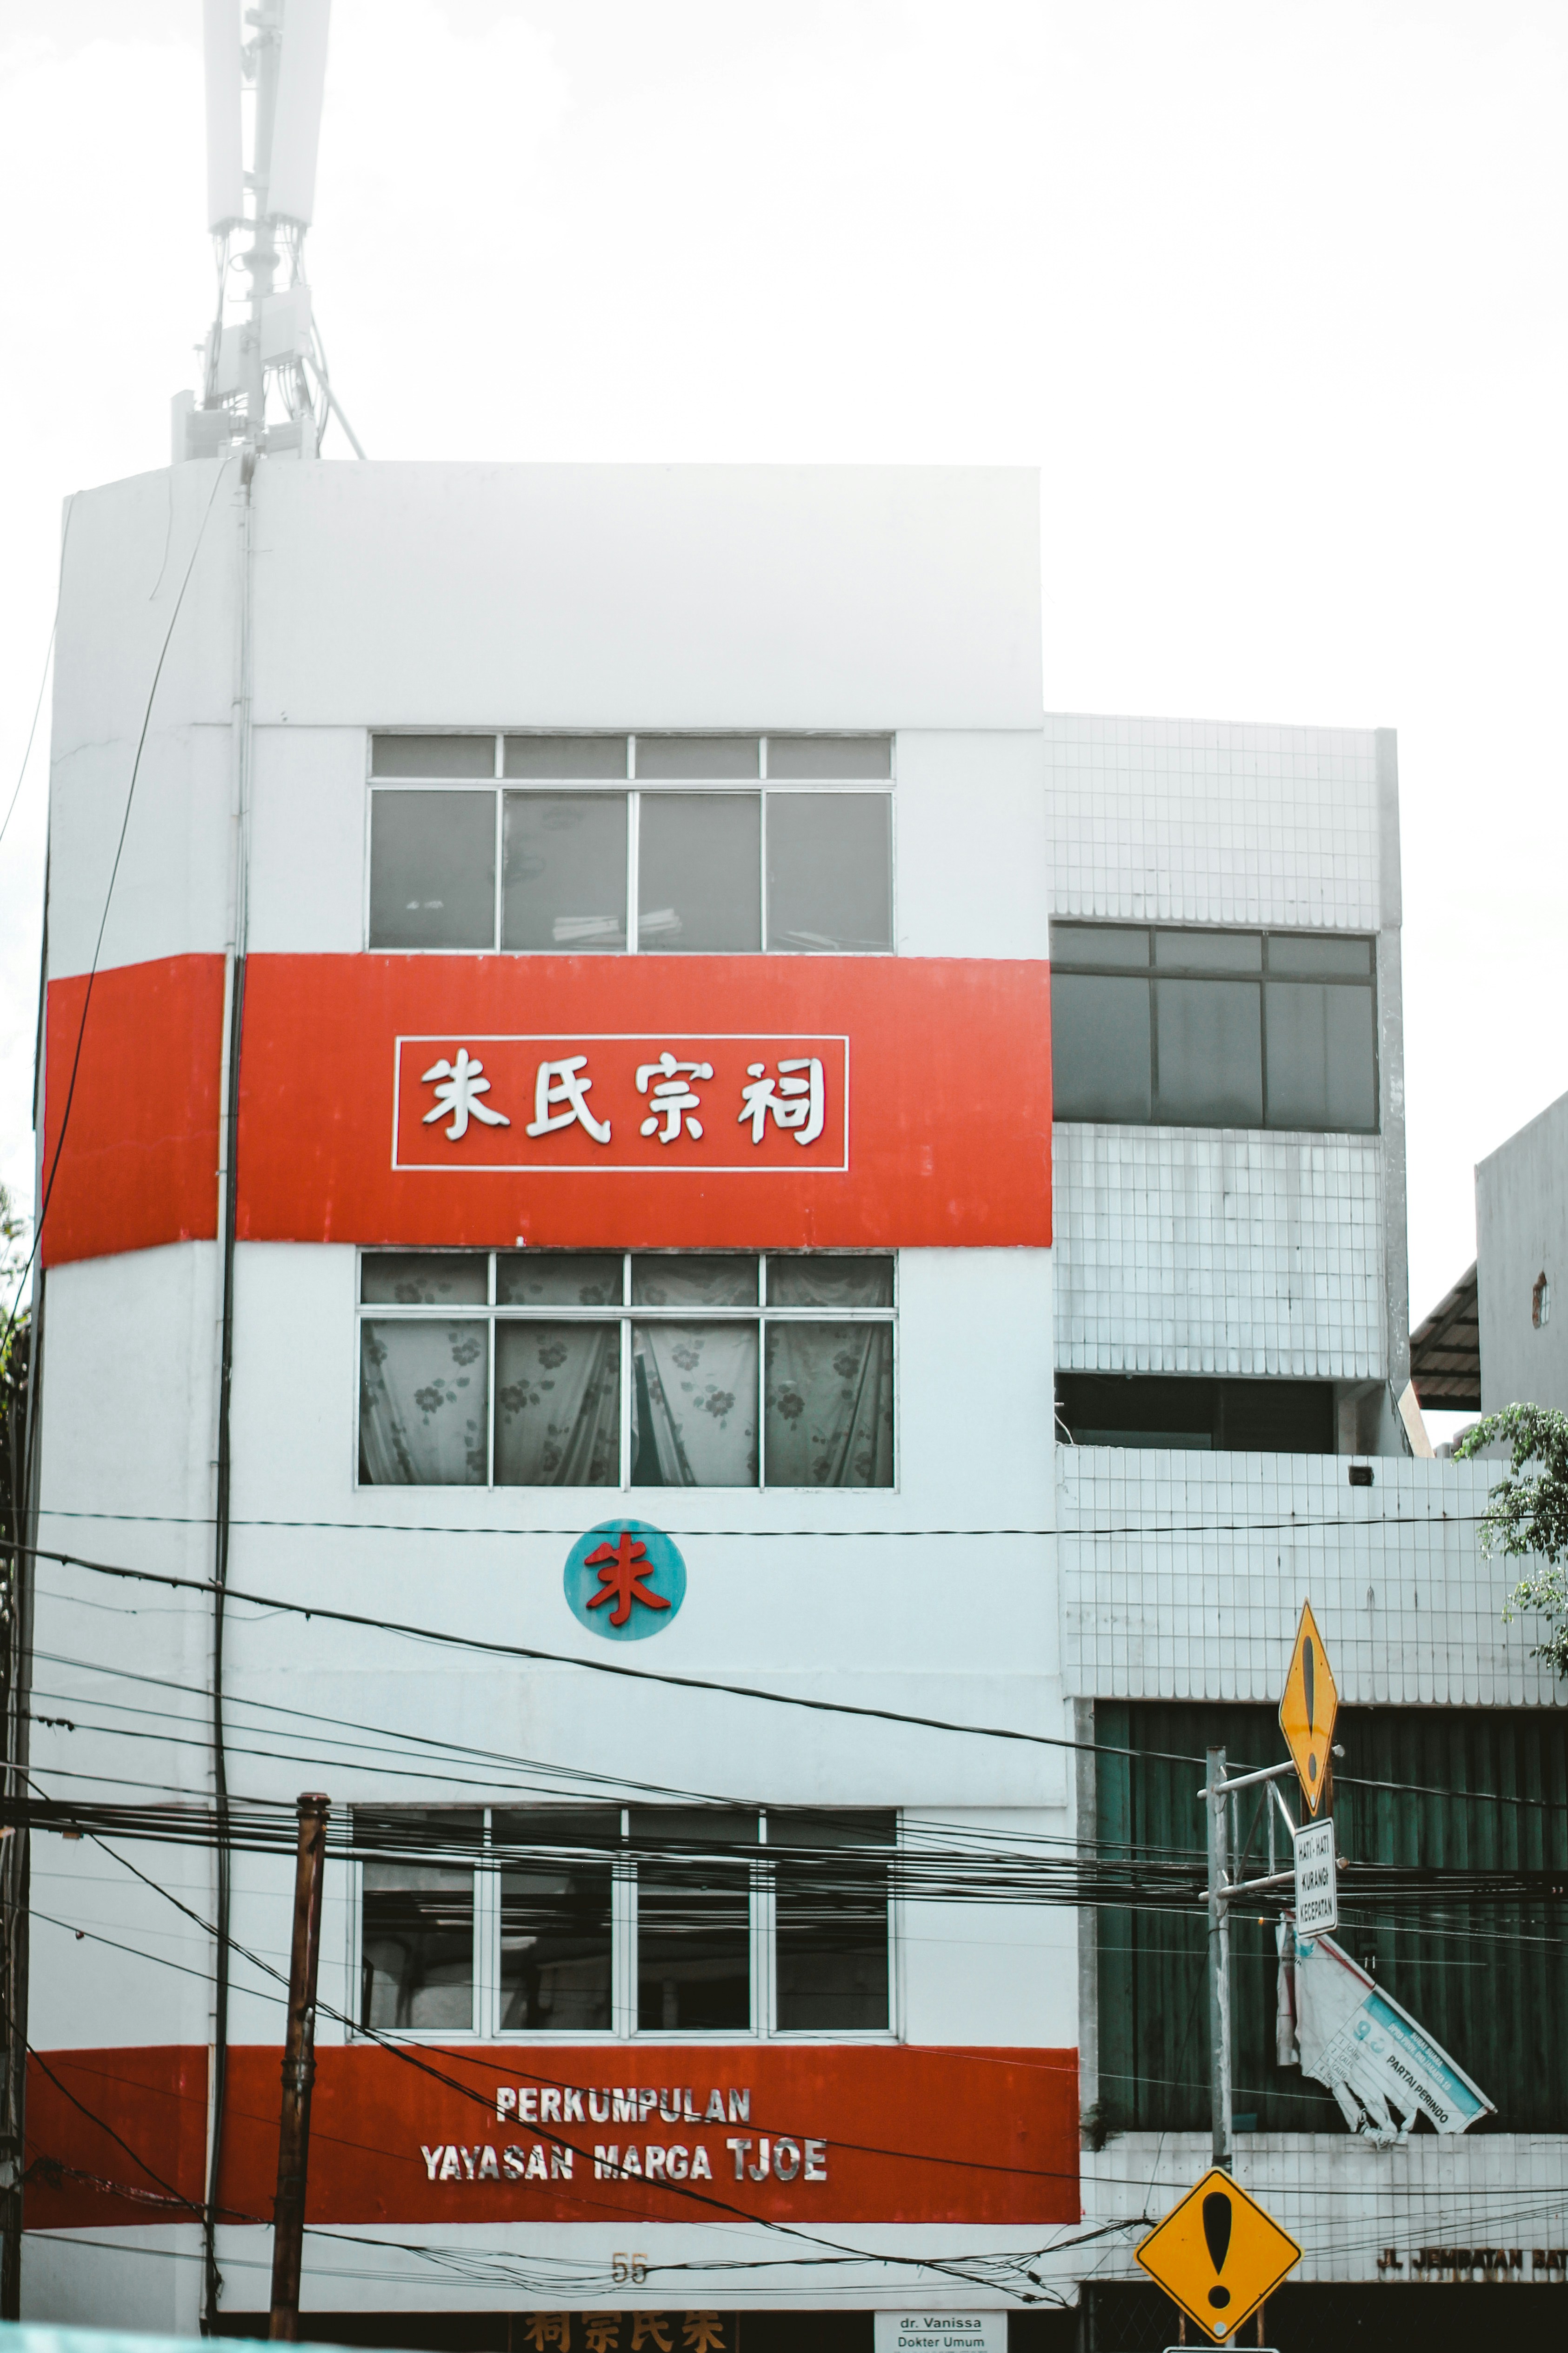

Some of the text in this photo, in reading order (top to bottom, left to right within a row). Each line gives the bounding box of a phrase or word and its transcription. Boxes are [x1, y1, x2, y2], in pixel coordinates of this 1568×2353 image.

[421, 1048, 825, 1145] 朱氏宗祠
[584, 1529, 671, 1626] 朱
[1299, 1839, 1312, 1861] HATI
[1316, 1834, 1329, 1857] HATI
[1301, 1866, 1329, 1892] KURANGI
[1300, 1897, 1332, 1924] KECEPATAN
[1386, 2055, 1417, 2088] PARTAI
[1414, 2085, 1448, 2124] PERINDO
[496, 2087, 750, 2123] PERKUMPULAN
[420, 2138, 828, 2182] YAYASAN MARGA TJOE
[1412, 2248, 1523, 2269] JEMBATAN
[901, 2318, 981, 2328] dr. Vanissa
[898, 2337, 985, 2347] Dokter Umum
